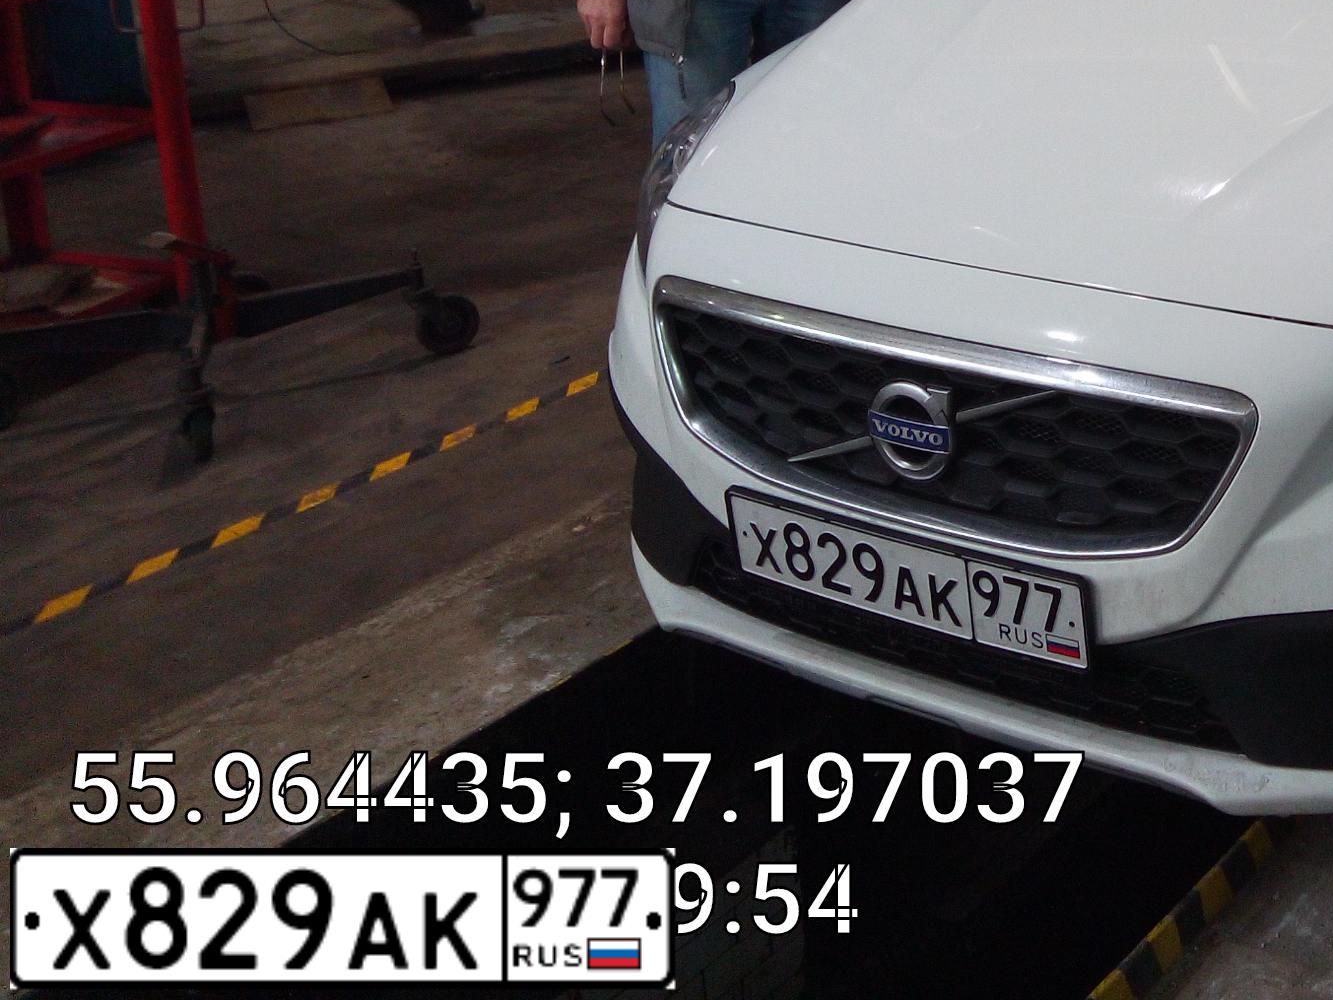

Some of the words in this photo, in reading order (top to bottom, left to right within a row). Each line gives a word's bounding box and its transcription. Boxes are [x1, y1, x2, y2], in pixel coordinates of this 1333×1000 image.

[871, 417, 945, 447] VOLVO
[972, 569, 1062, 633] 977
[999, 623, 1045, 650] RUS
